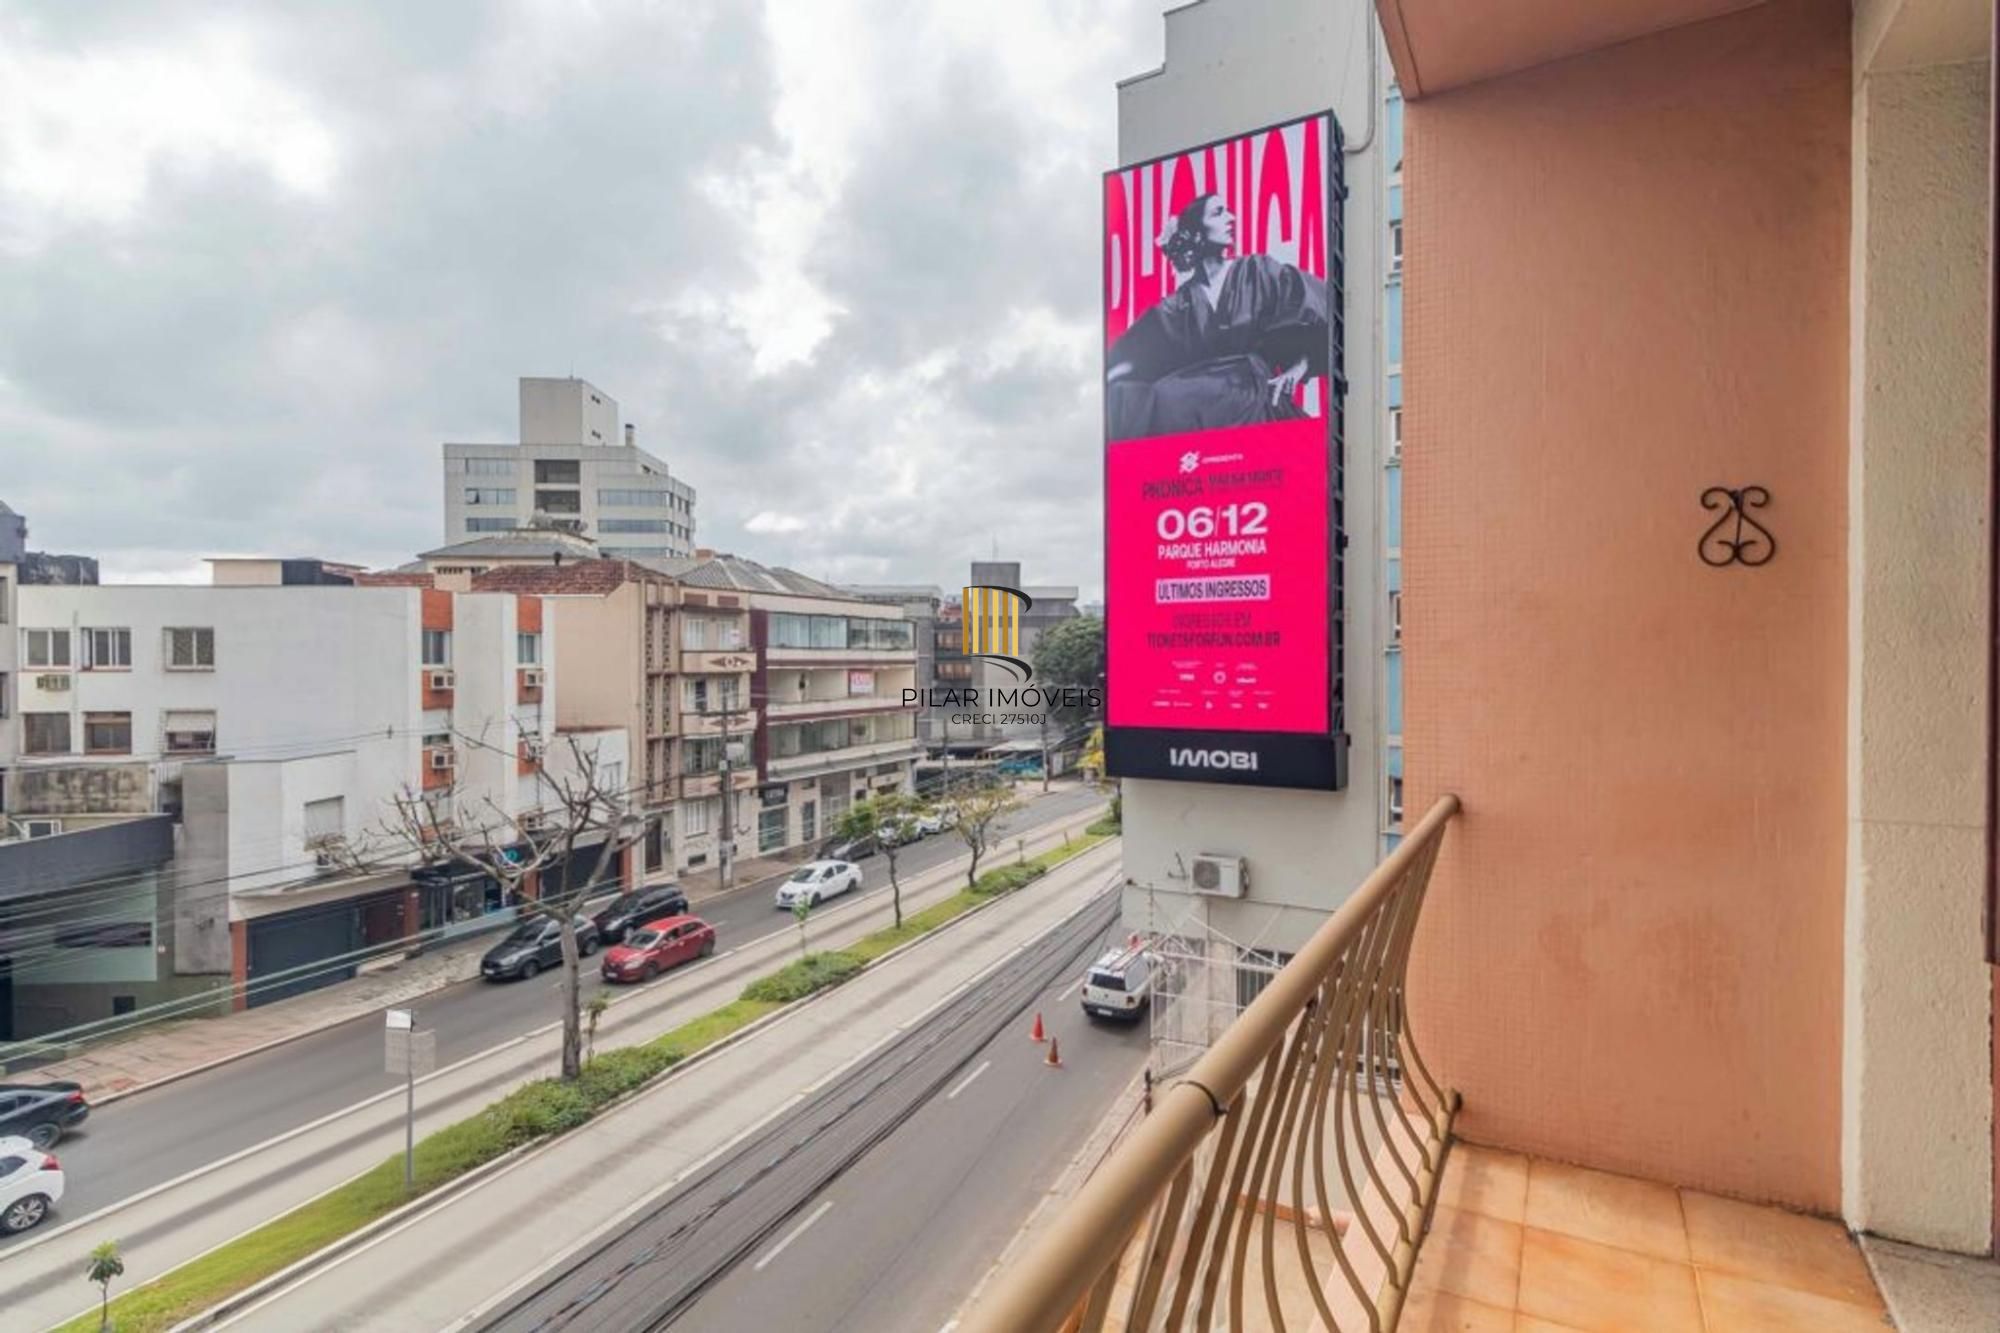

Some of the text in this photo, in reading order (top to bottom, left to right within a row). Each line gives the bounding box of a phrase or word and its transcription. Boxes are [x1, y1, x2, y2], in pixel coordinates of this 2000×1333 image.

[1157, 502, 1269, 541] 06/12
[1158, 539, 1267, 559] PARQUE HARMONIA
[1205, 579, 1267, 597] INGRESSOS
[1169, 748, 1259, 771] IMOBI
